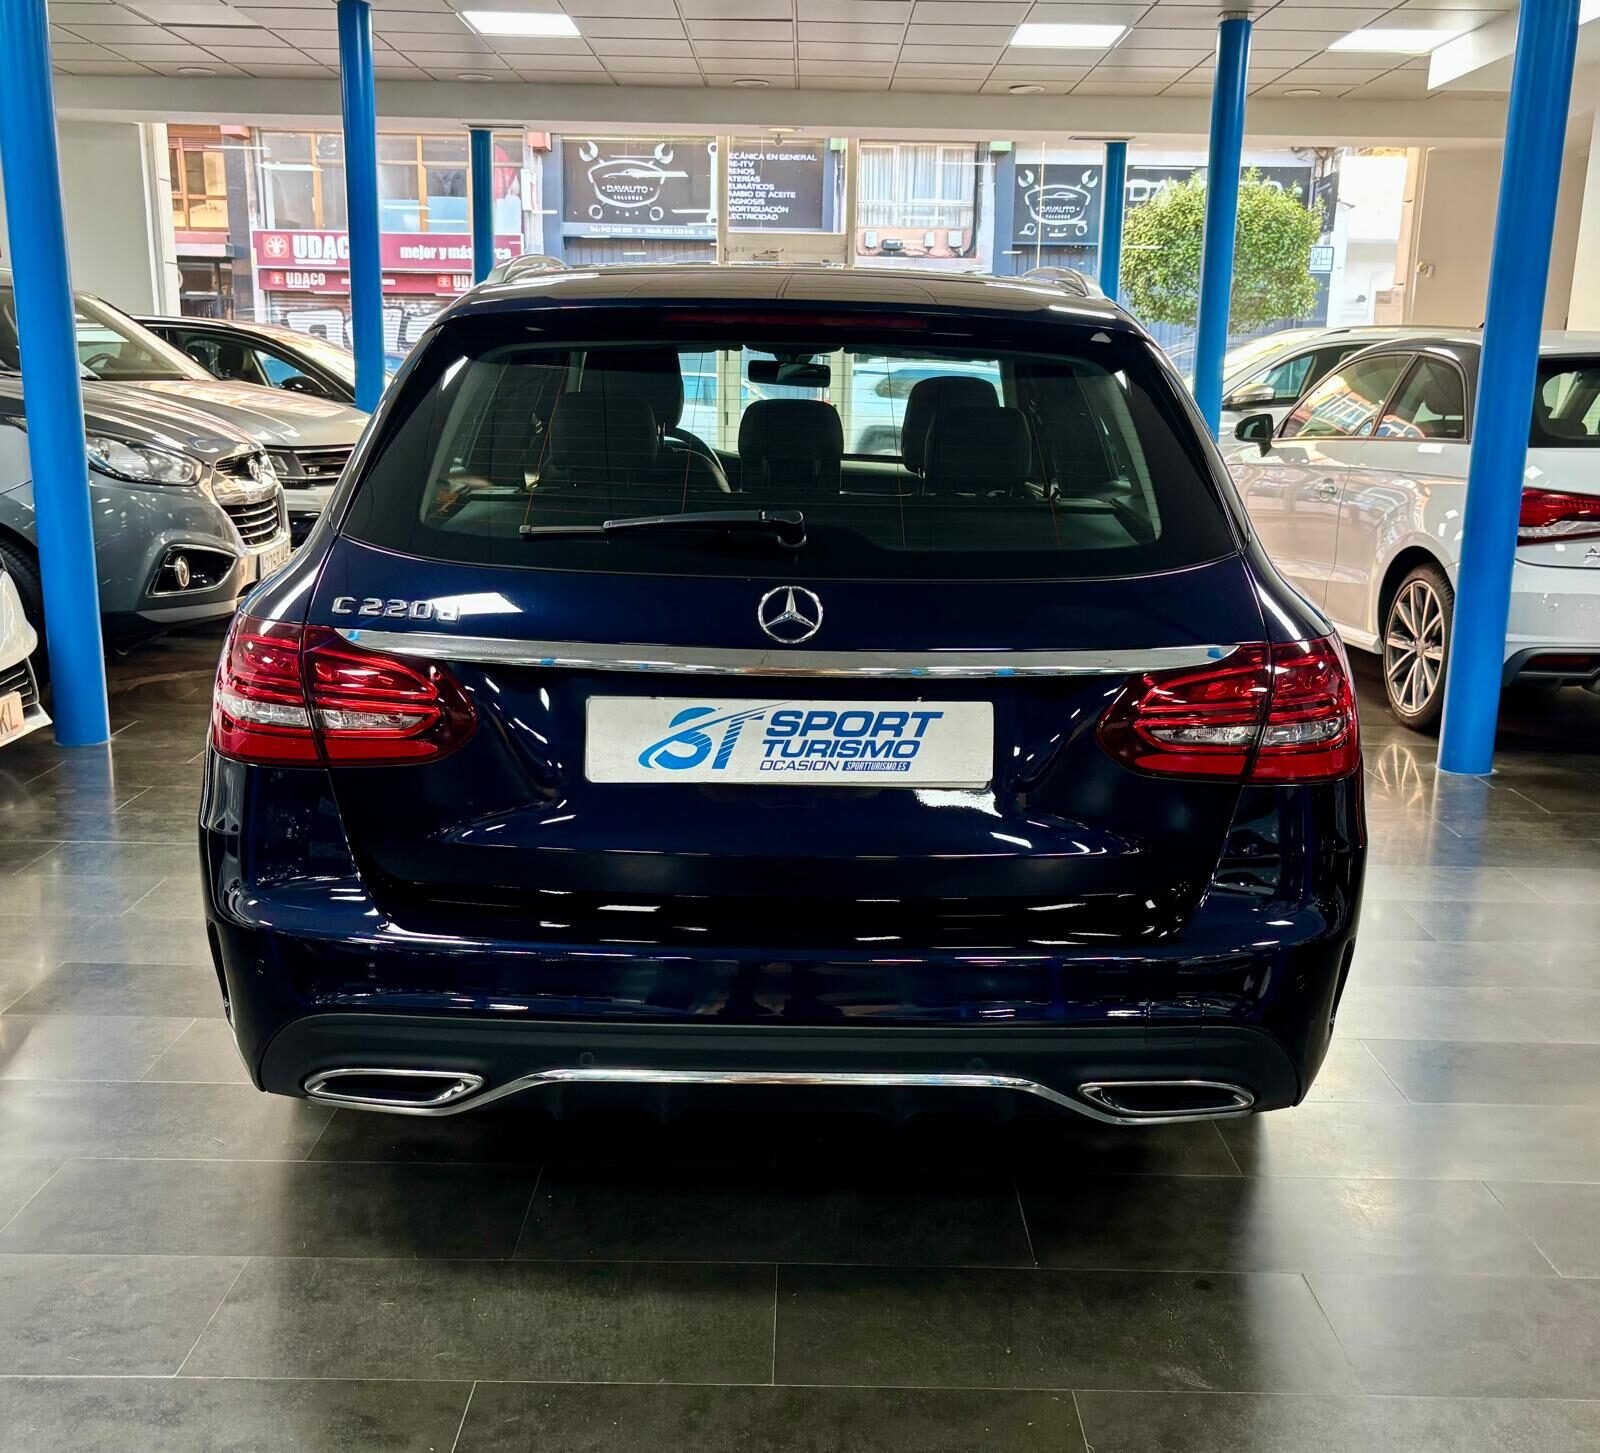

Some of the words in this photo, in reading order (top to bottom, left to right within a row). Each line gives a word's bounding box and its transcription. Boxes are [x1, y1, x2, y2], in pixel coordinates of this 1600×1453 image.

[729, 152, 765, 160] ECÁNICA
[729, 175, 760, 183] ATERÍAS
[606, 185, 648, 194] DAVAUTO
[729, 190, 754, 198] AMBIO
[768, 191, 796, 199] ACEITE
[729, 205, 789, 213] MORTIGUACIÓN
[292, 234, 349, 260] UDAC
[400, 245, 437, 260] mejor
[438, 247, 446, 260] y
[285, 272, 326, 286] UDACO
[331, 596, 357, 615] C
[766, 710, 944, 738] SPORT
[762, 739, 921, 759] TURISMO
[759, 760, 839, 771] OCASION
[845, 761, 908, 772] SPORTTURISMO.ES
